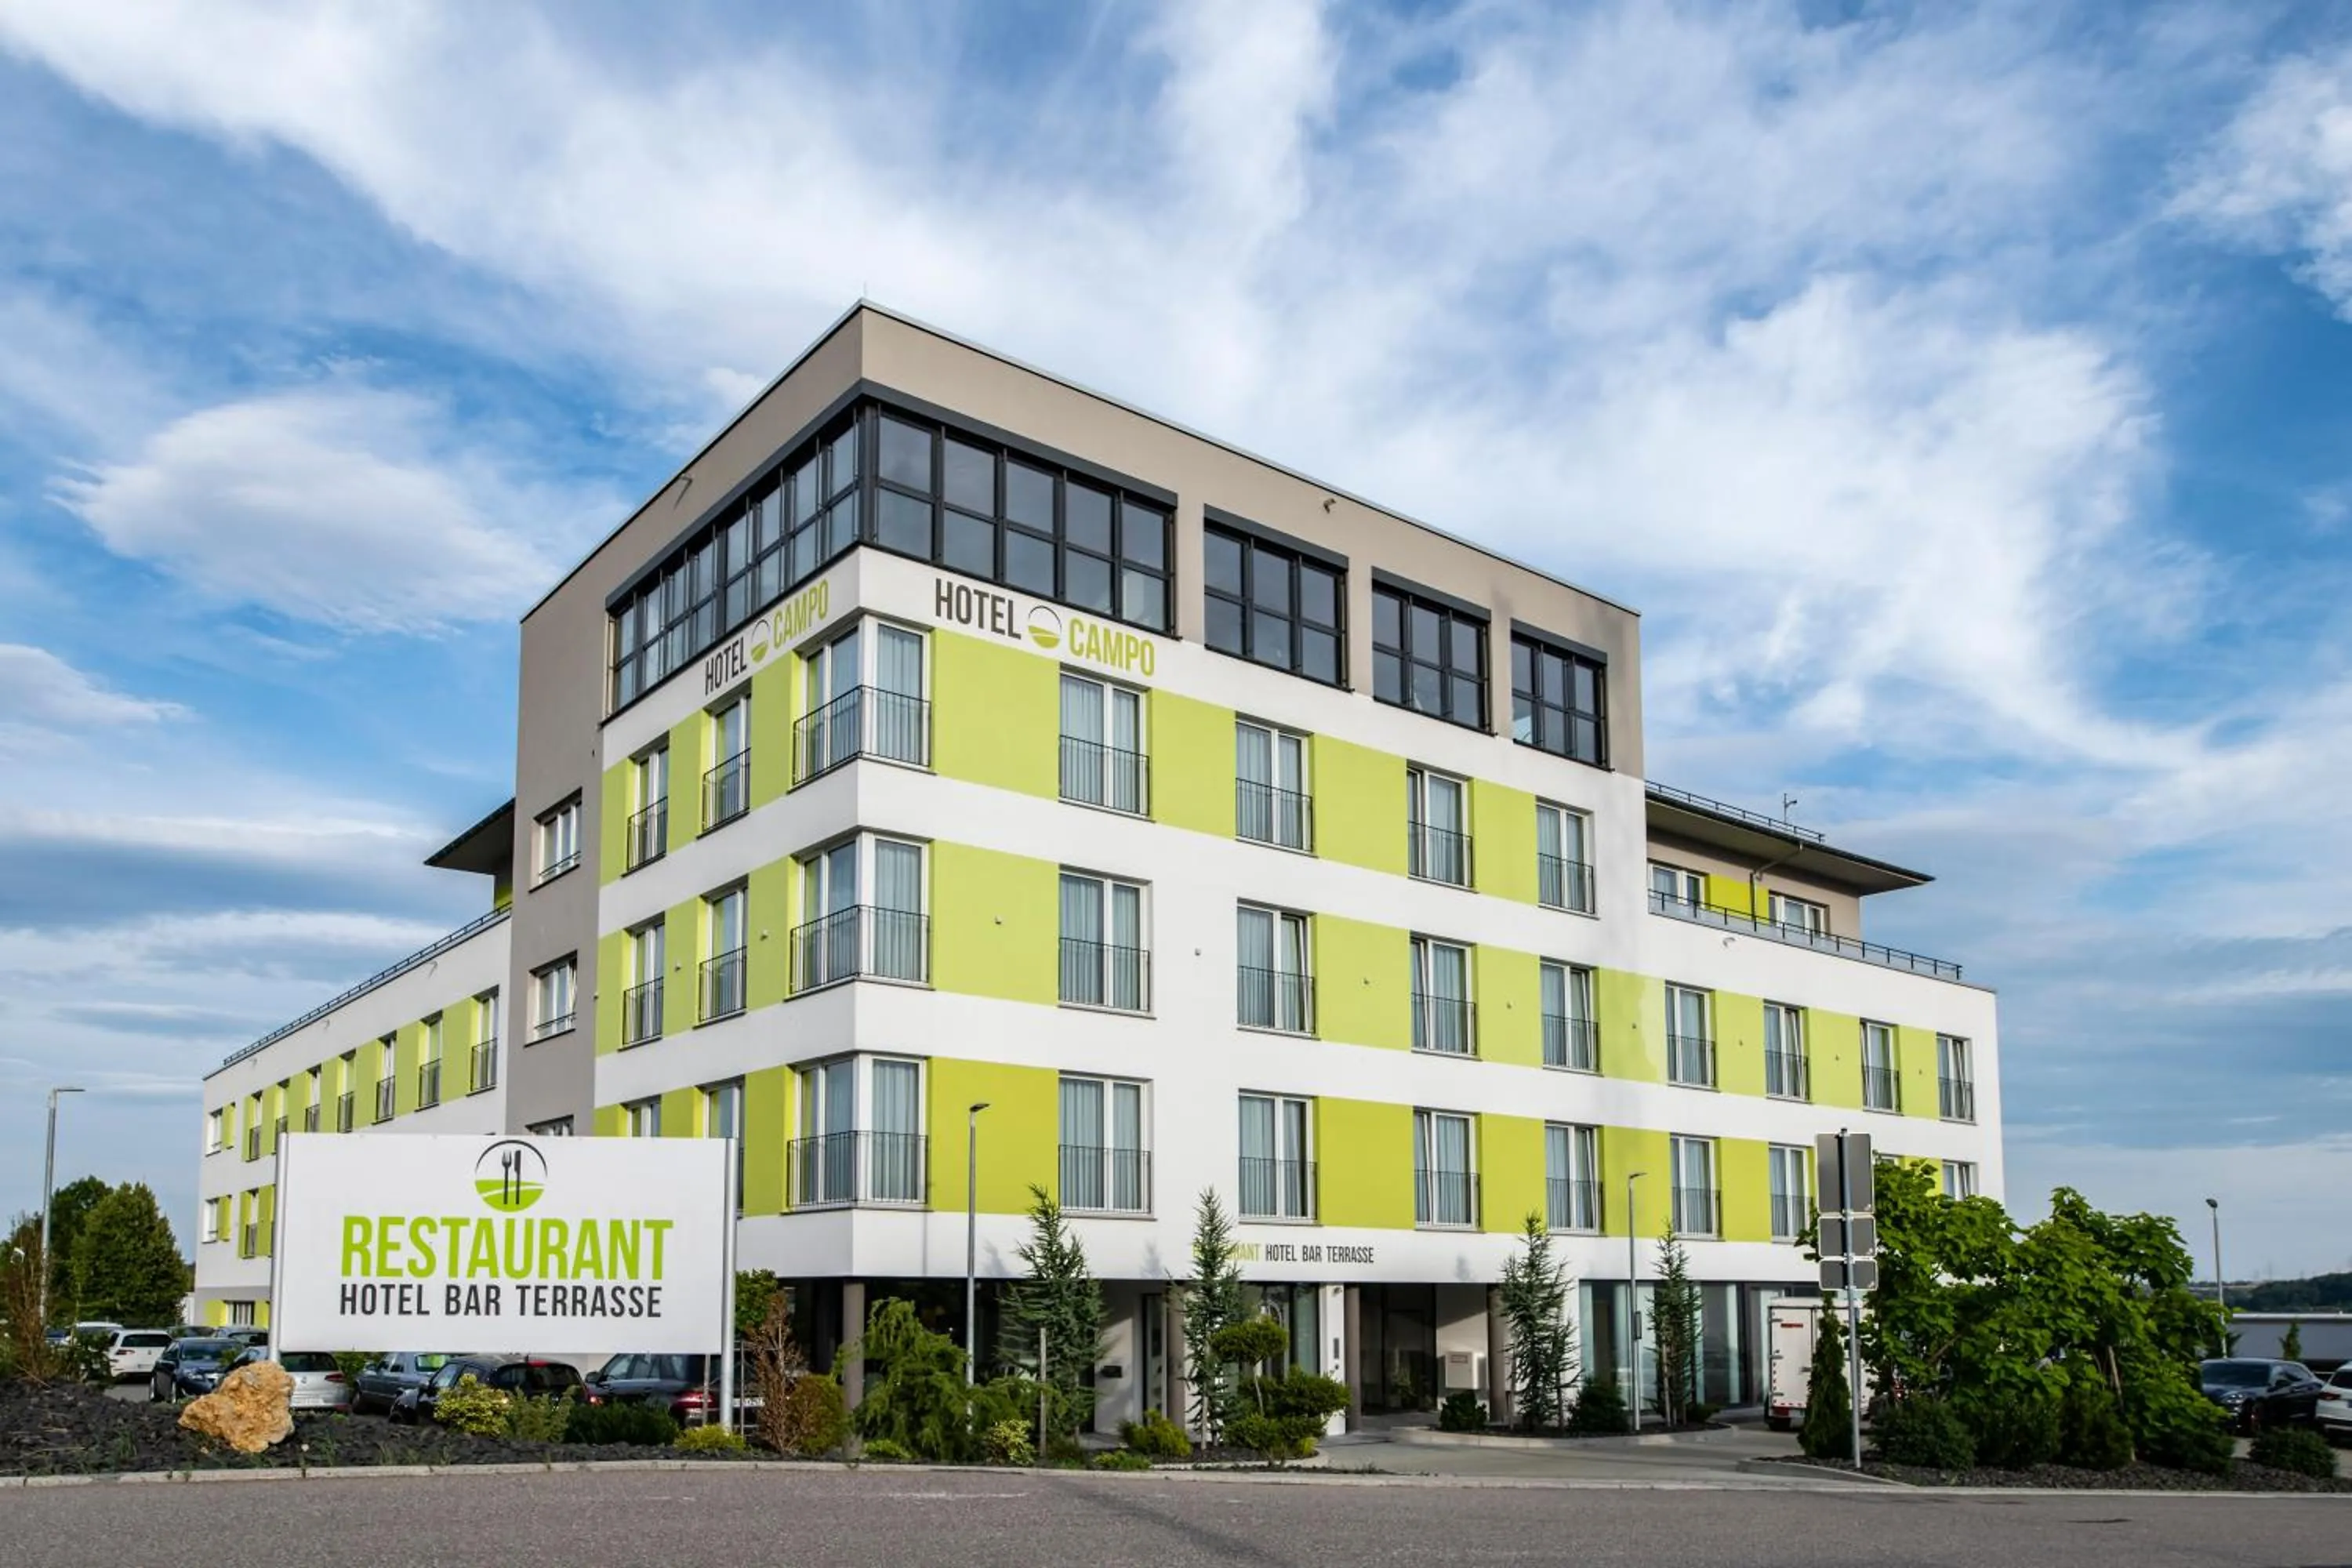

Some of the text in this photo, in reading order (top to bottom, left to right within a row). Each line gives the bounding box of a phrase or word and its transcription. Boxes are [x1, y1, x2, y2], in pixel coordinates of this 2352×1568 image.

[705, 579, 829, 696] HOTEL CAMPO
[935, 578, 1156, 677] HOTEL CAMPO
[340, 1215, 674, 1280] RESTAURANT
[1265, 1243, 1298, 1262] HOTEL
[1301, 1244, 1323, 1262] BAR
[1326, 1245, 1375, 1264] TERRASSE
[339, 1283, 662, 1318] HOTEL BAR TERRASSE
